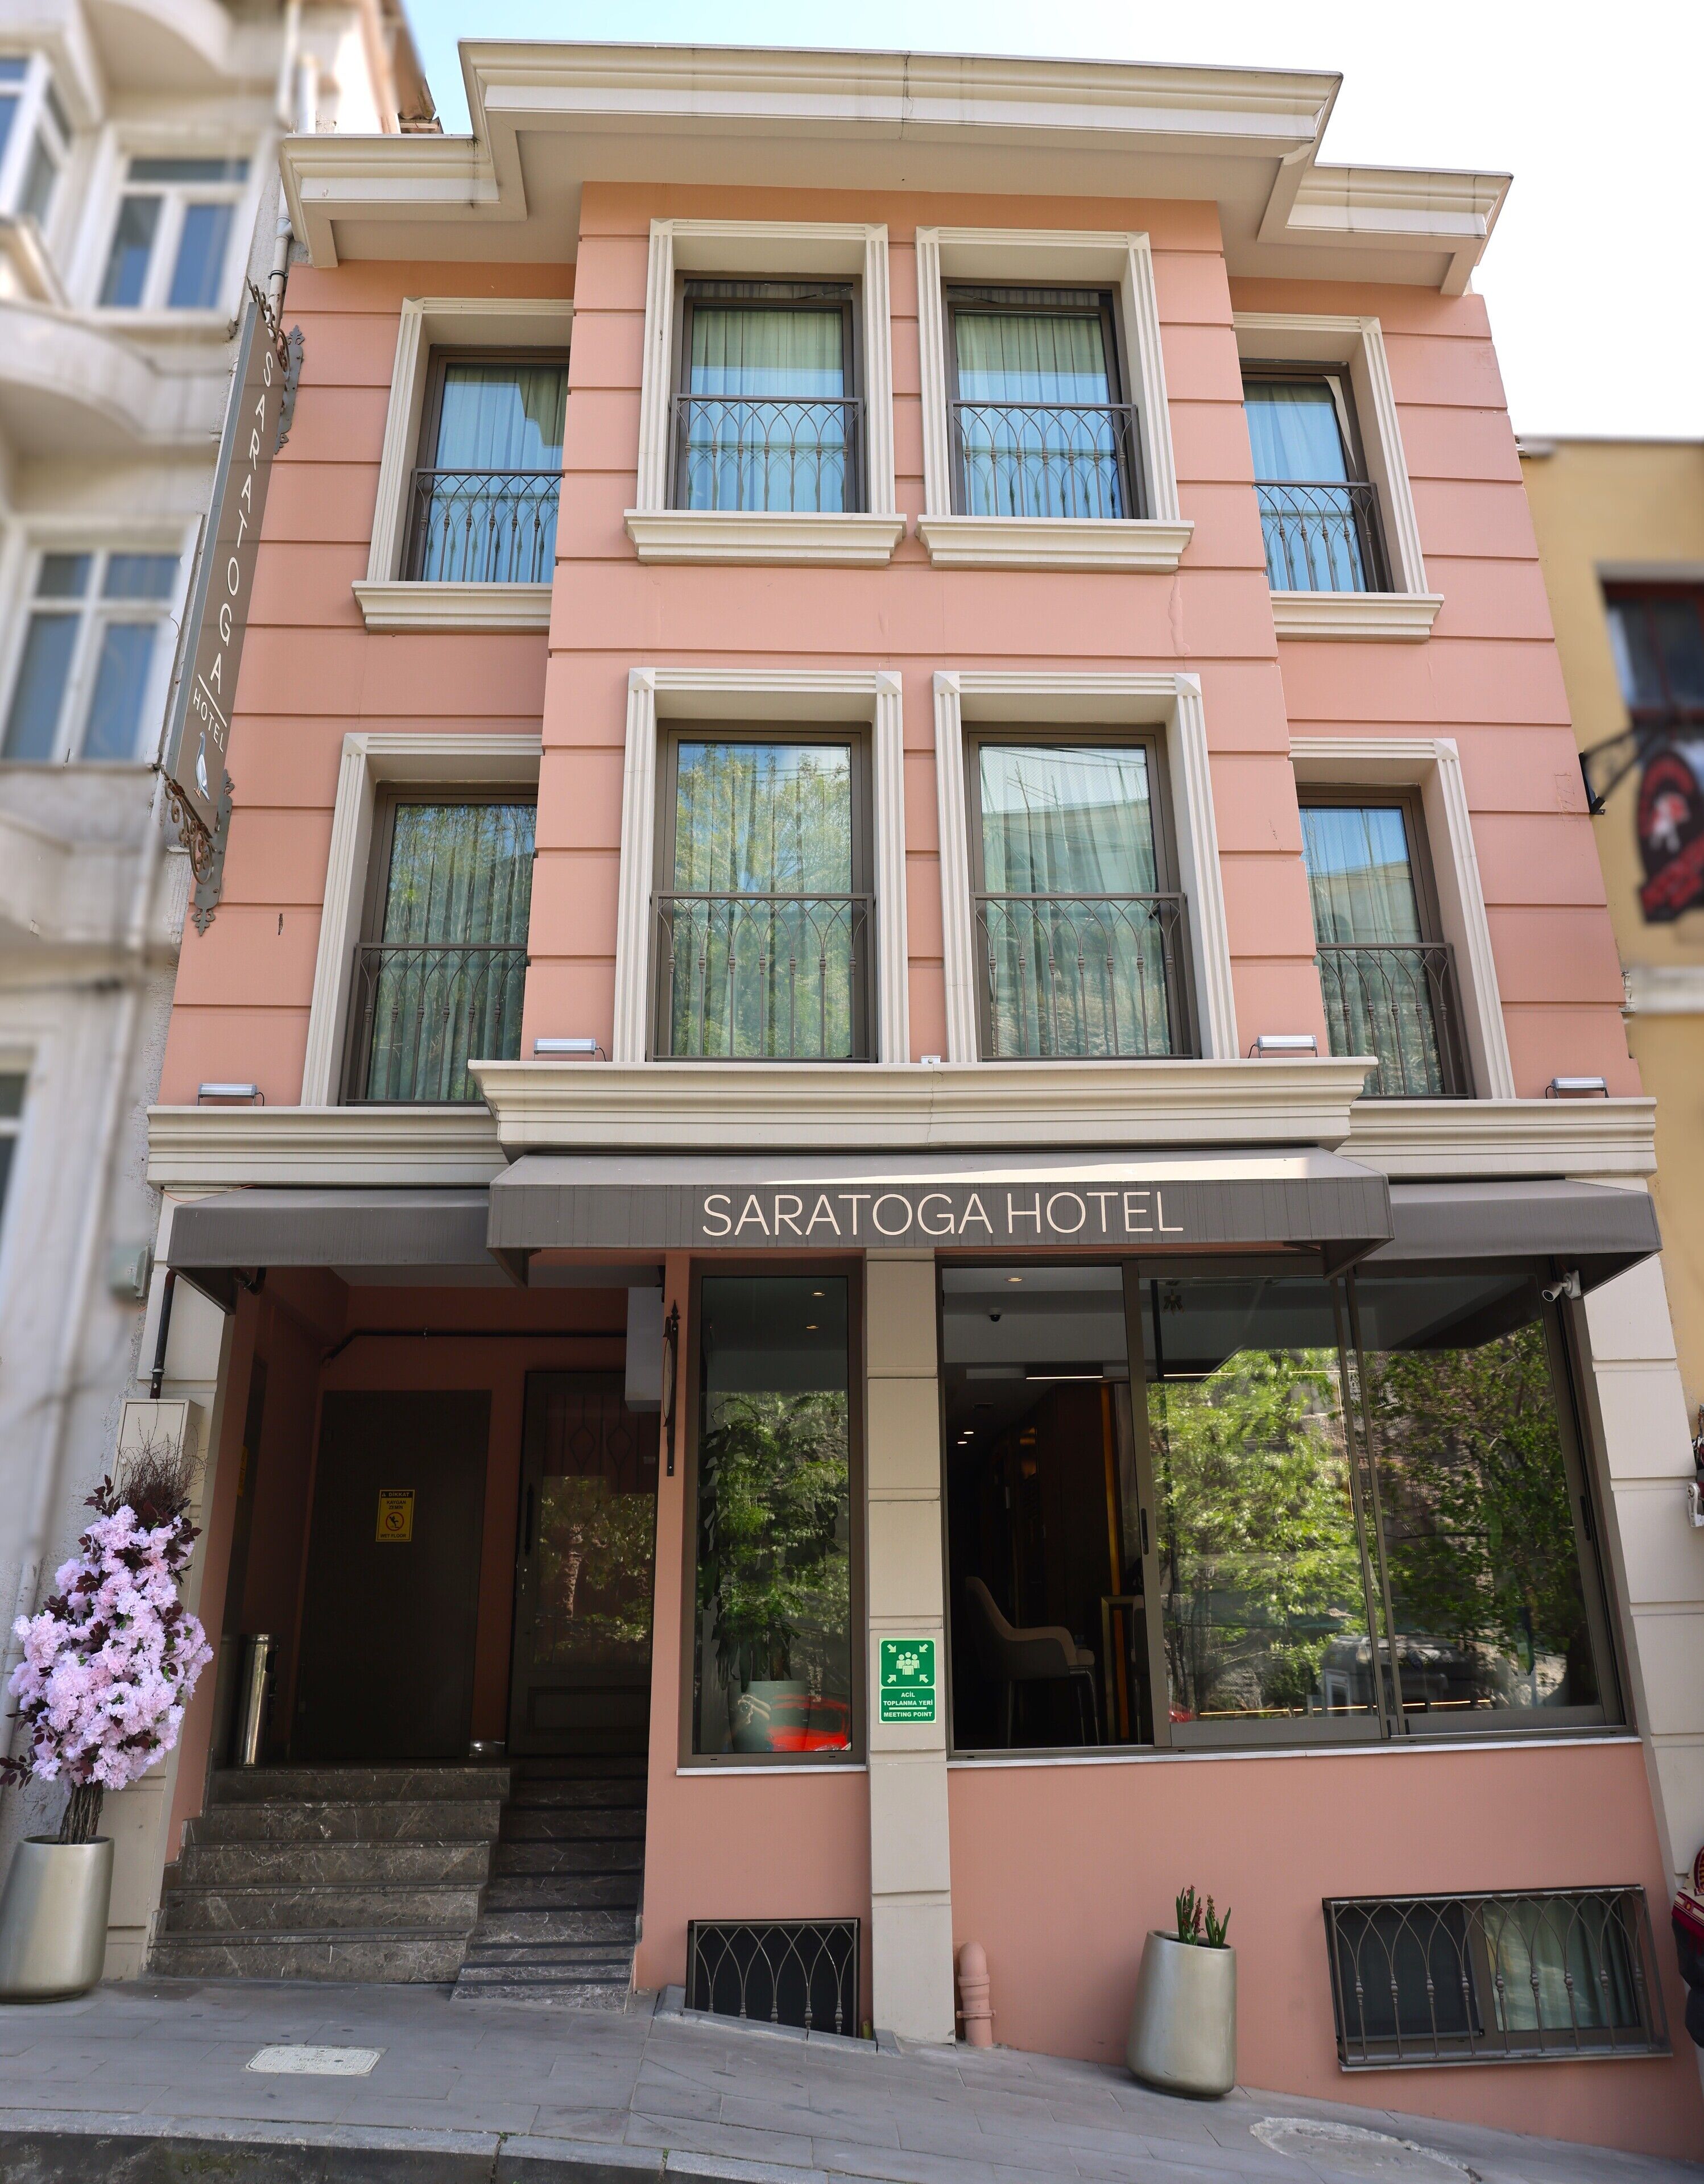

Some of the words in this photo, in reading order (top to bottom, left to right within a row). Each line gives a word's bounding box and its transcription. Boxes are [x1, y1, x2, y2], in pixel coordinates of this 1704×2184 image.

[210, 351, 273, 694] SARATOGA
[193, 688, 224, 752] HOTEL
[702, 1193, 994, 1236] SARATOGA
[1008, 1191, 1184, 1235] HOTEL
